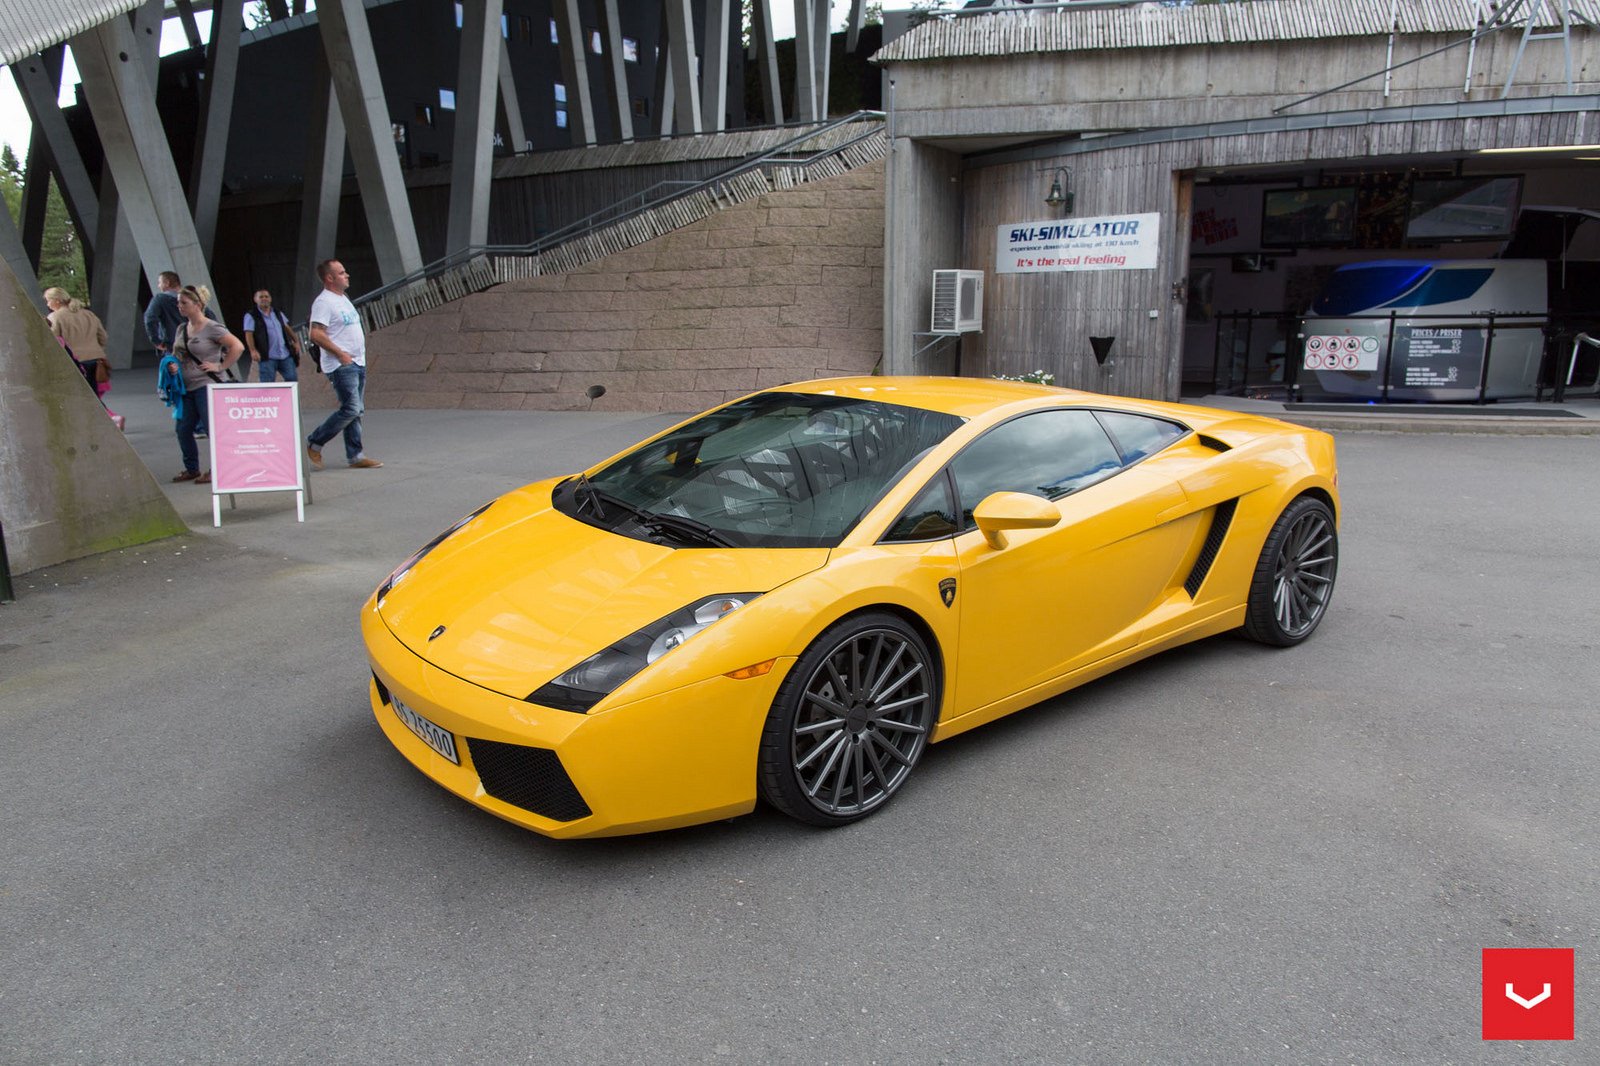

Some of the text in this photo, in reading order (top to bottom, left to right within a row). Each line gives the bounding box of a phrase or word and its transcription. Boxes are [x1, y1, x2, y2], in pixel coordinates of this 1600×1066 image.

[1010, 220, 1139, 243] SKI-SIMULATOR
[1010, 245, 1042, 253] experience
[1071, 241, 1093, 249] skiing
[1017, 254, 1126, 267] It's the real feeling
[228, 406, 279, 419] OPEN
[410, 710, 452, 757] 25500
